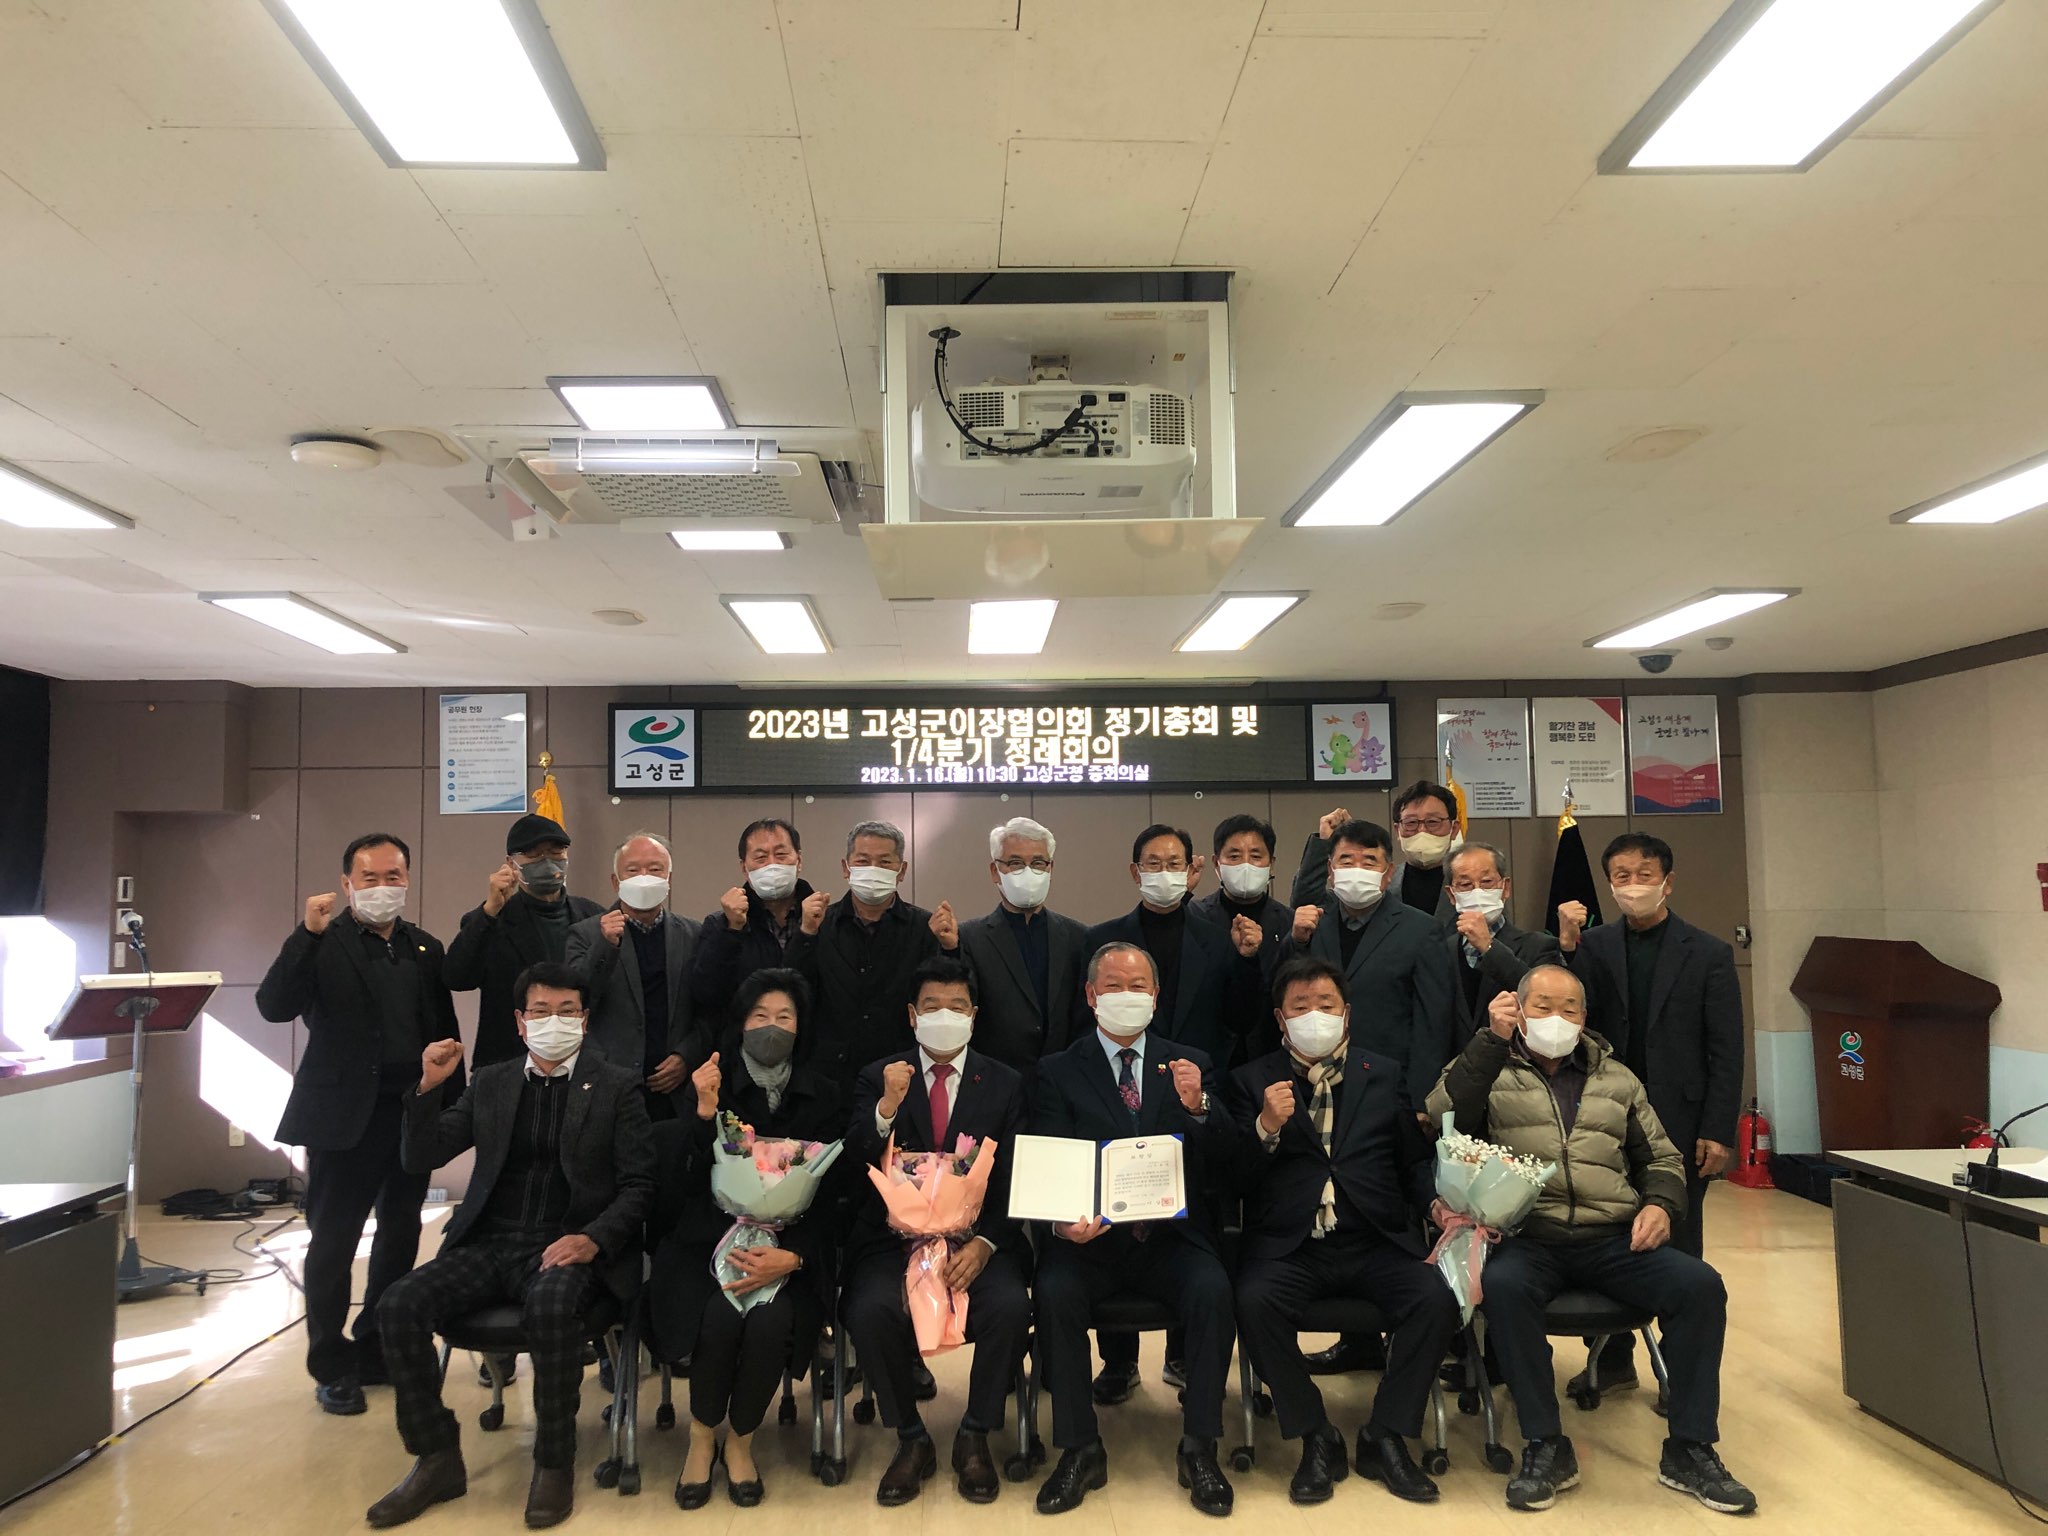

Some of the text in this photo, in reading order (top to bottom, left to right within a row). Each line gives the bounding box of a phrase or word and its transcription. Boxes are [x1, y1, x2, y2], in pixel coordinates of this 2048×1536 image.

[748, 704, 1259, 739] 2023년 고성군이장협의회 정기총회 및
[1578, 732, 1596, 742] 도민
[891, 735, 1120, 767] 1/4분기 정례회의
[625, 764, 685, 782] 고성군
[1022, 765, 1084, 783] 고성군청
[1840, 1063, 1865, 1081] 고성군
